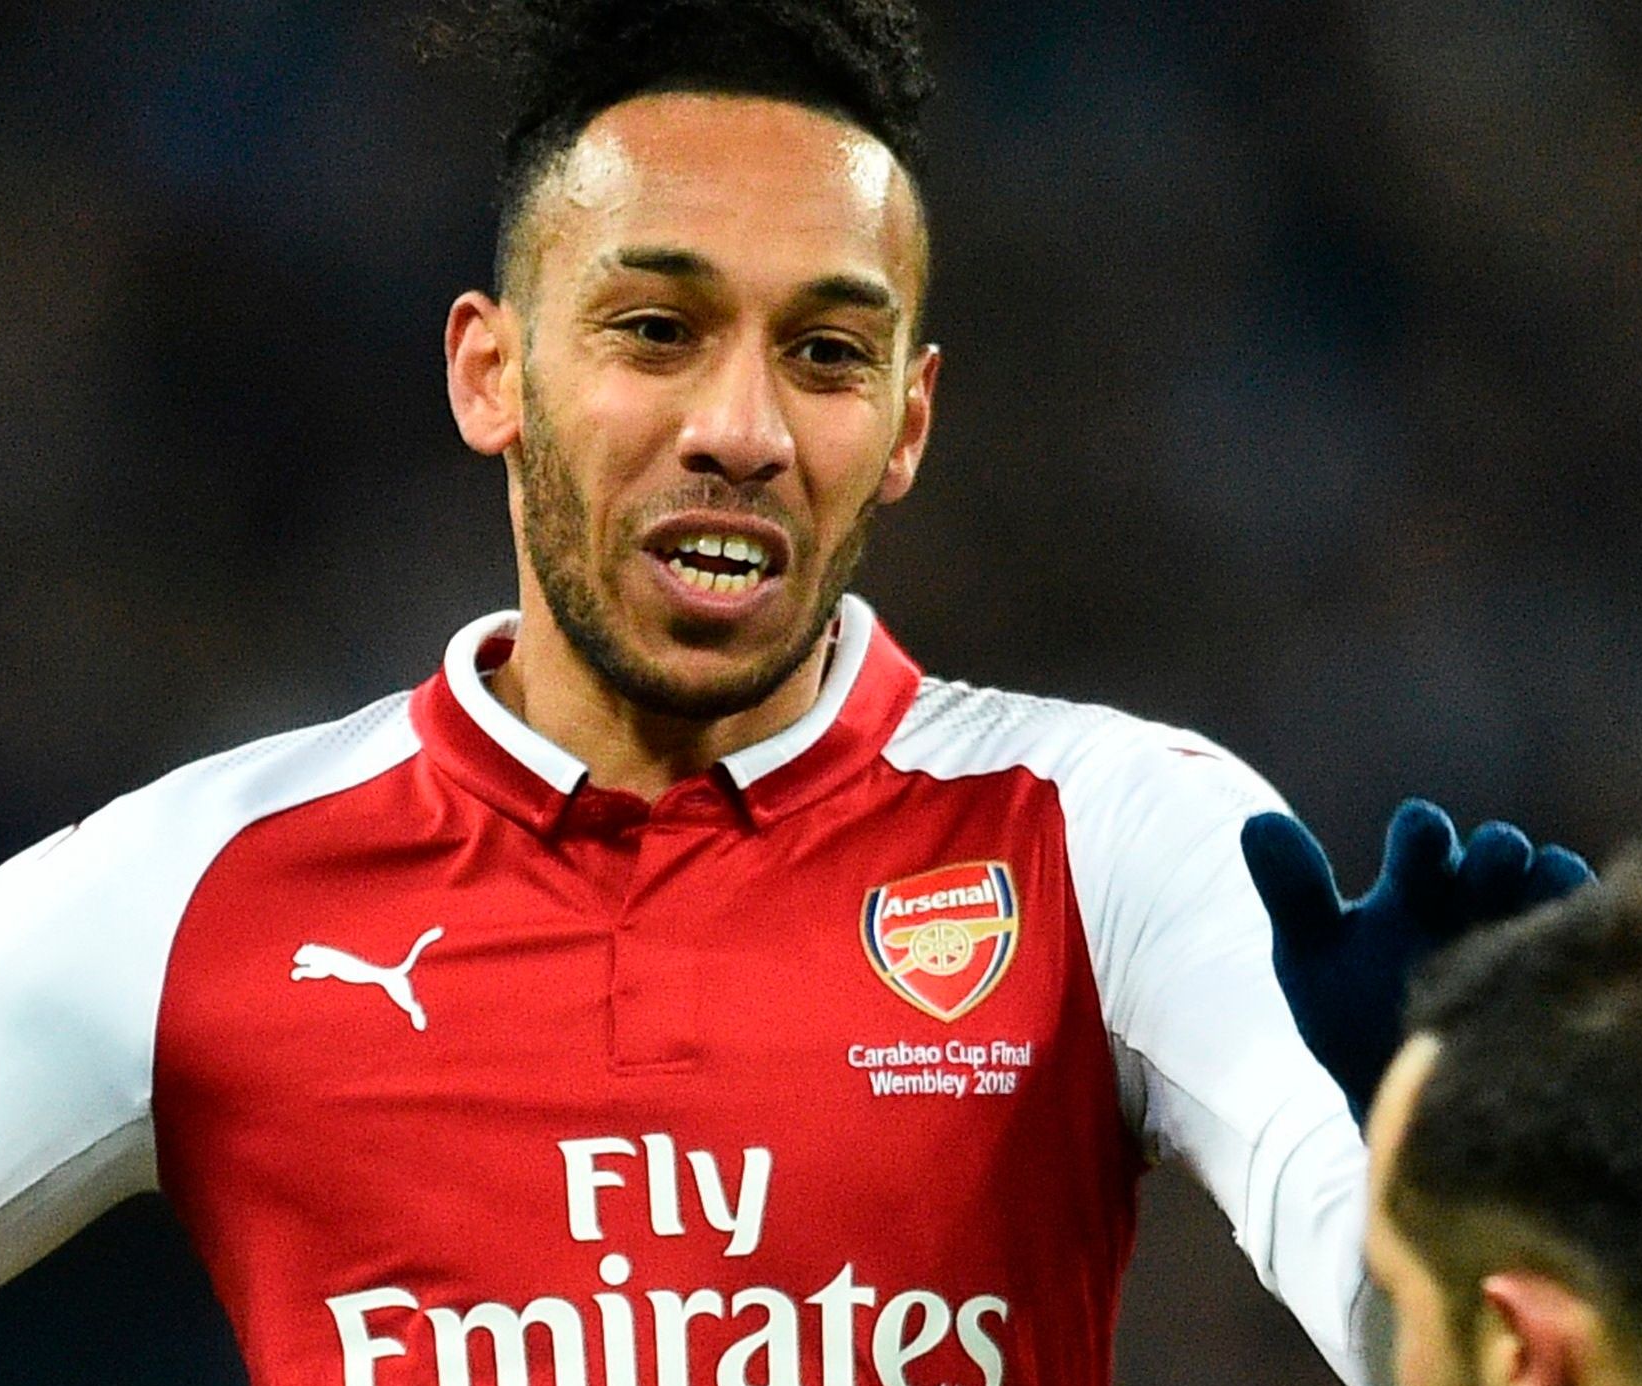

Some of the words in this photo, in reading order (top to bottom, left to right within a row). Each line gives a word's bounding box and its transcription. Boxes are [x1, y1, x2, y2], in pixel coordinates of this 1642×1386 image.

[882, 879, 997, 919] Arsenal
[847, 1041, 942, 1068] Carabao
[945, 1040, 987, 1069] Cup
[990, 1040, 1032, 1067] Final
[869, 1070, 966, 1098] Wembley
[973, 1071, 1017, 1095] 2018
[558, 1133, 772, 1256] Fly
